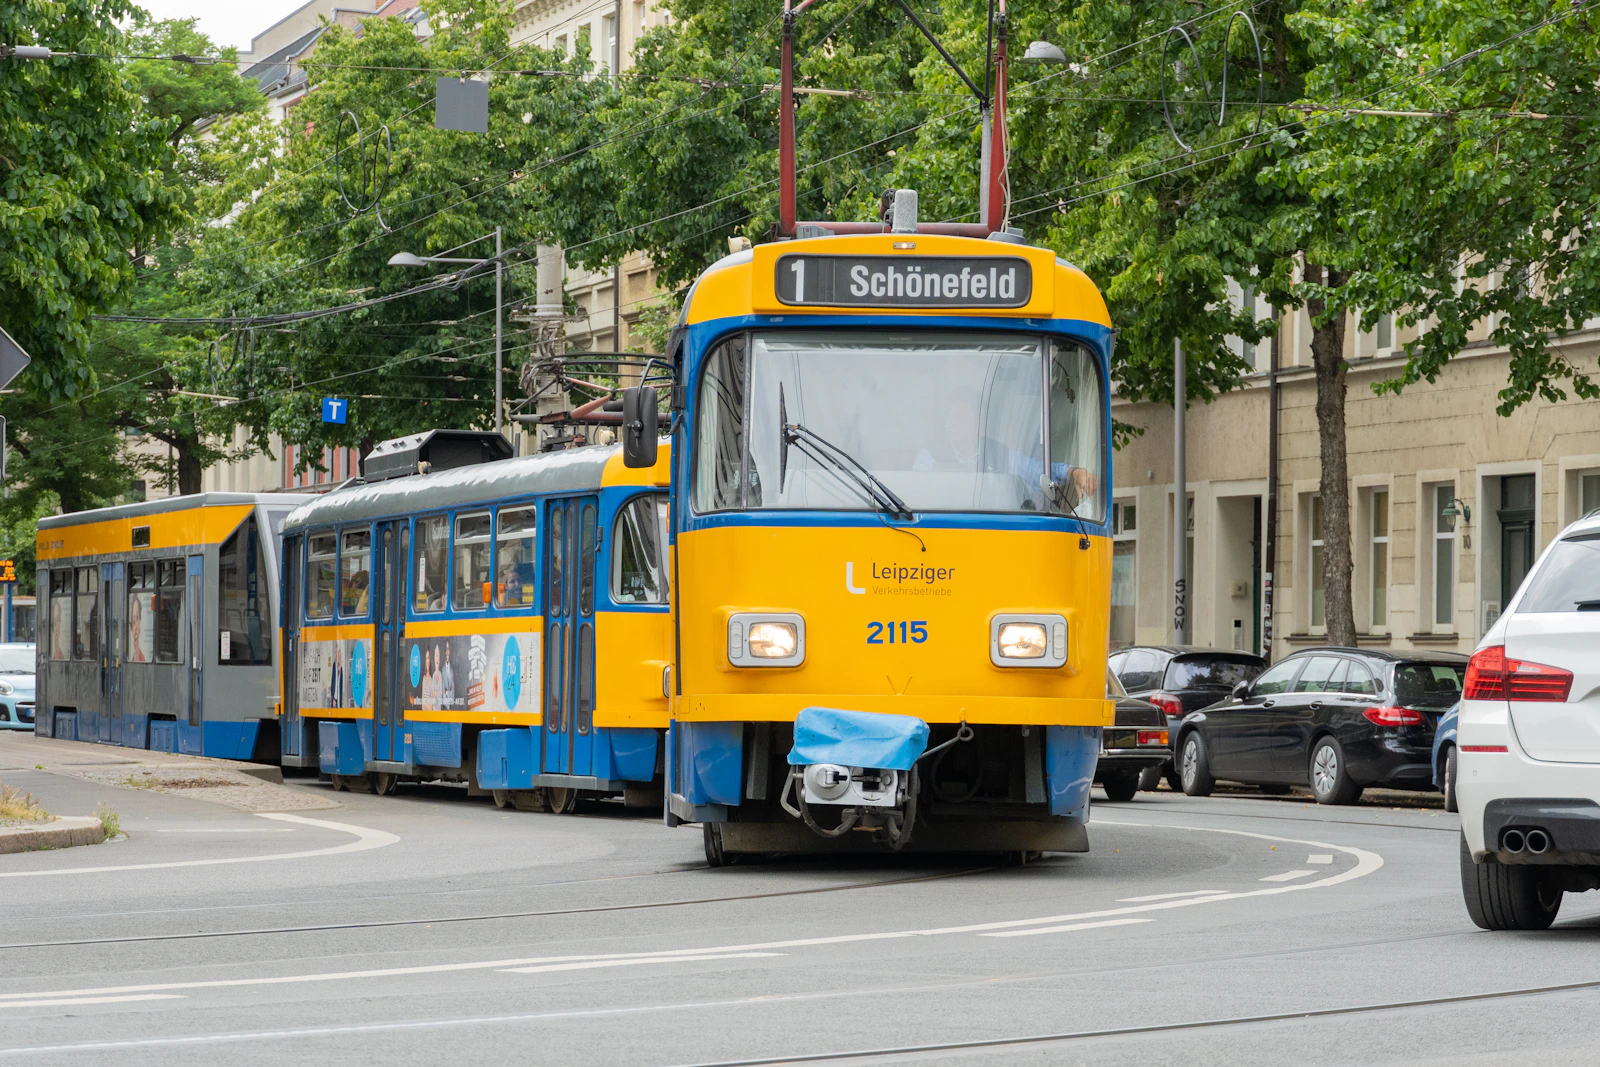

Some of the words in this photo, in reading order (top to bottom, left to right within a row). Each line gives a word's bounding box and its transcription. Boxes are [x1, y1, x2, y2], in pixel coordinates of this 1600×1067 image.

[791, 259, 805, 302] 1
[850, 265, 1015, 298] Schönefeld
[328, 400, 342, 420] T
[1462, 535, 1471, 549] 10
[872, 562, 955, 584] Leipziger
[872, 586, 952, 596] Verkehrsbetriebe
[1174, 579, 1185, 629] SNOW
[866, 621, 928, 644] 2115
